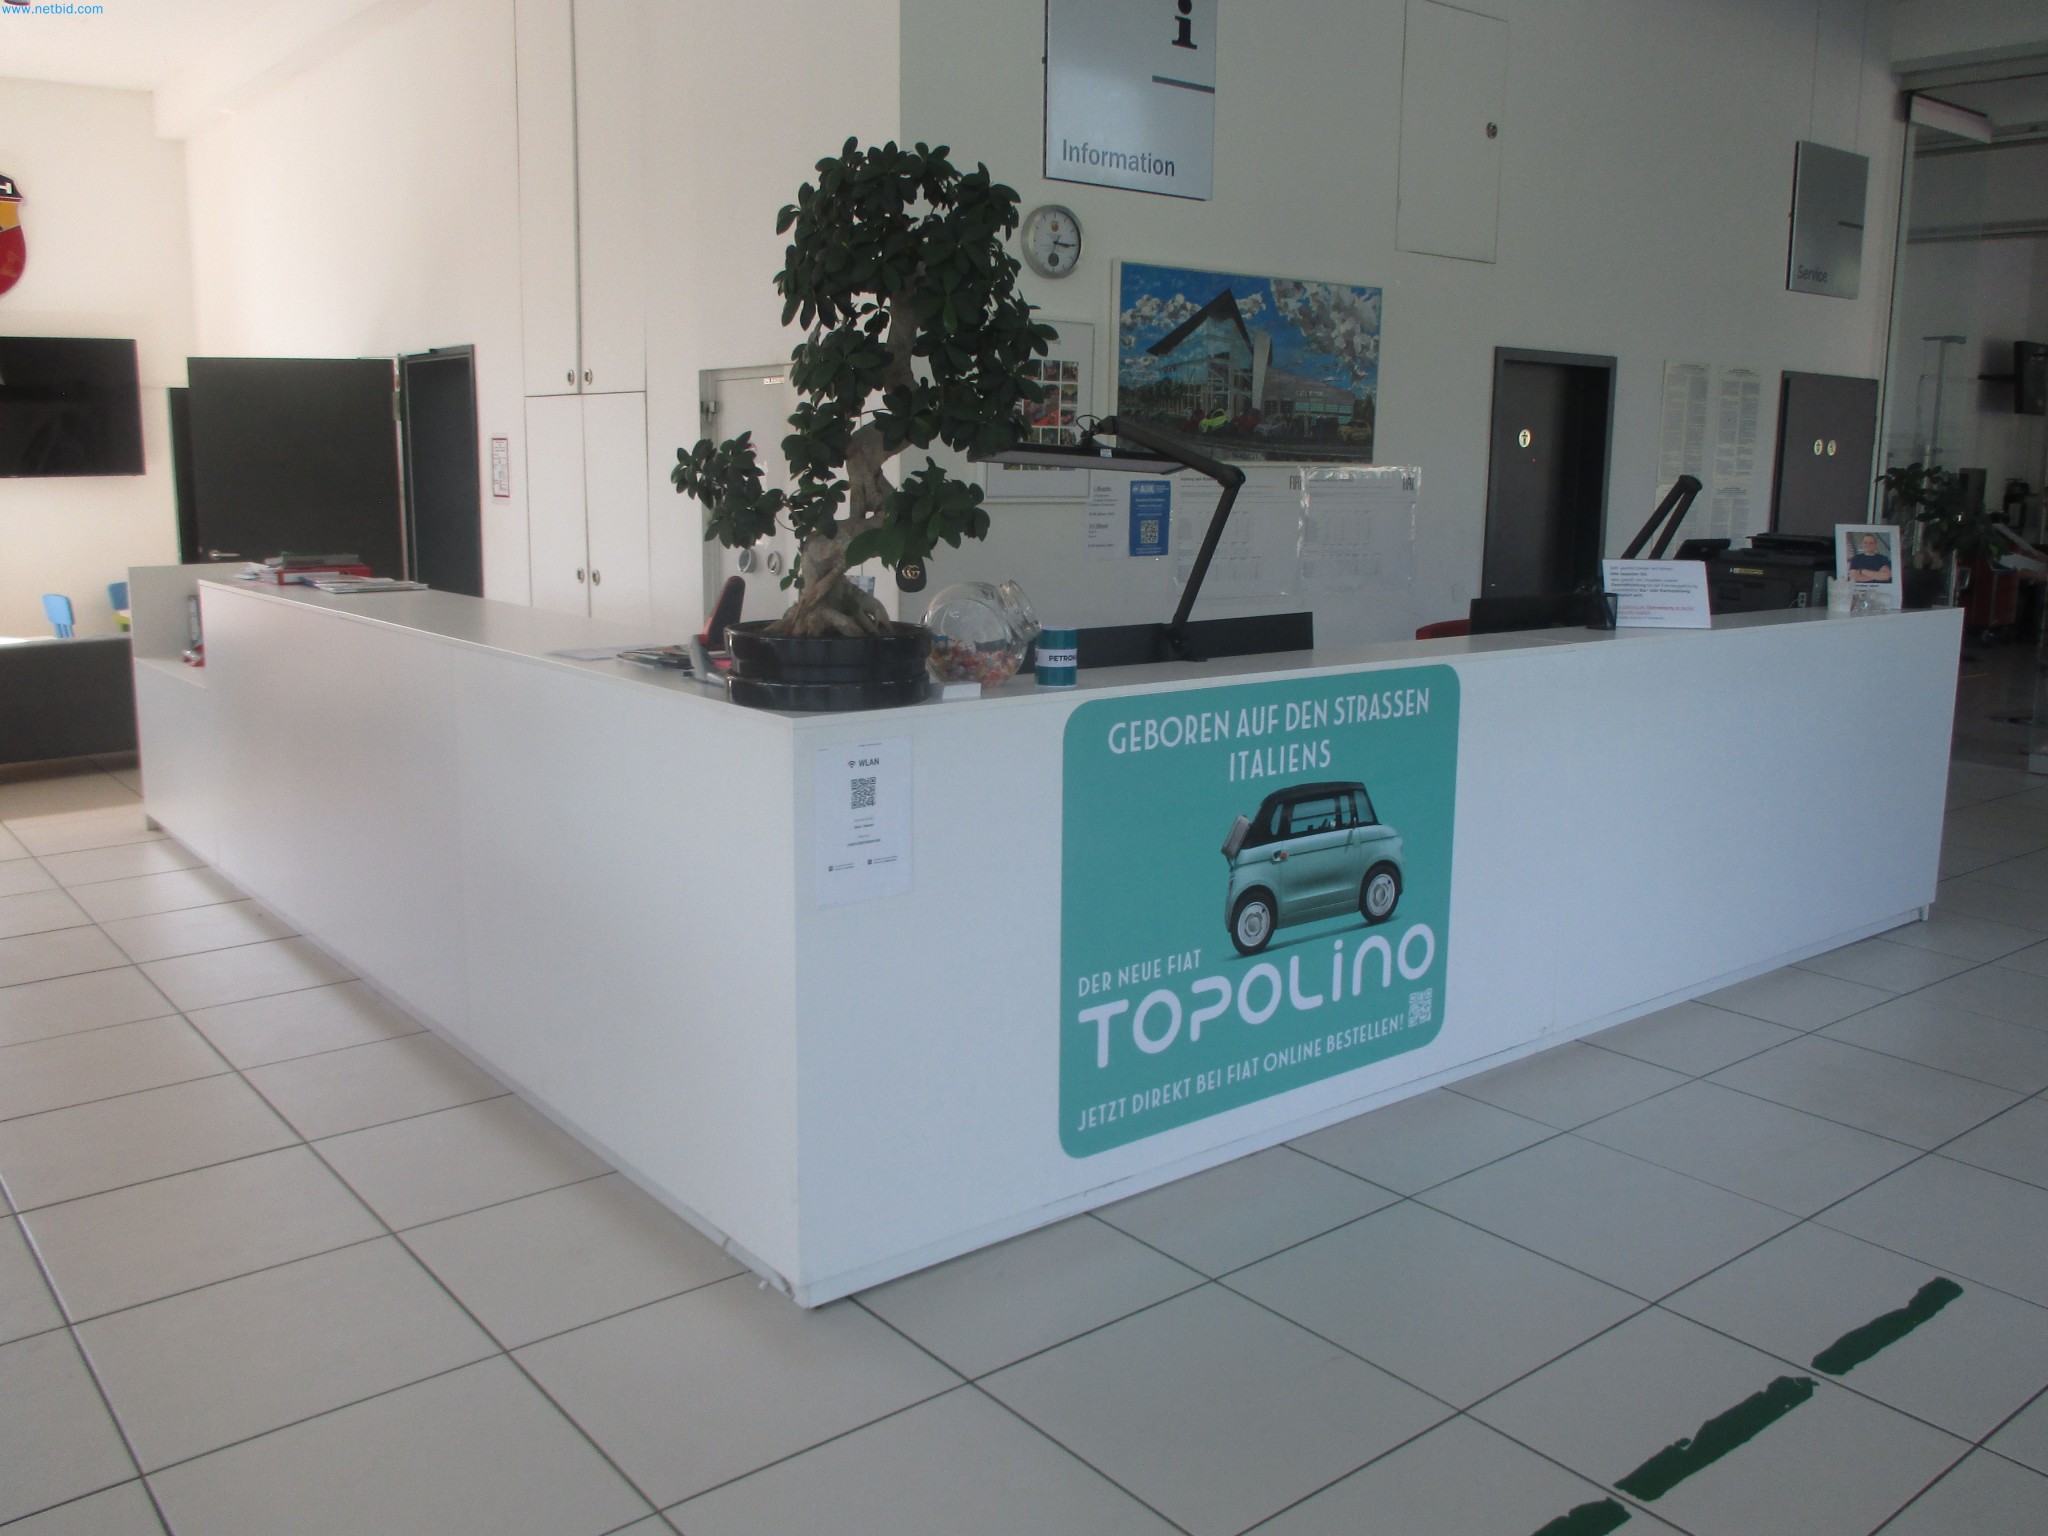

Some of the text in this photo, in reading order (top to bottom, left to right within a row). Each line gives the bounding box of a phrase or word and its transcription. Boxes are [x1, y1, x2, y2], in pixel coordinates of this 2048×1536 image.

[1062, 139, 1175, 177] Information
[1797, 264, 1828, 283] Service
[1107, 687, 1430, 755] GEBOREN AUF DEN STRASSEN
[858, 757, 880, 768] WLAN
[1229, 739, 1332, 782] ITALIENS
[1078, 949, 1202, 998] DER NEUE FIAT
[1077, 1013, 1404, 1132] JETZT DIREKT BEI FIAT ONLINE BESTELLEN!
